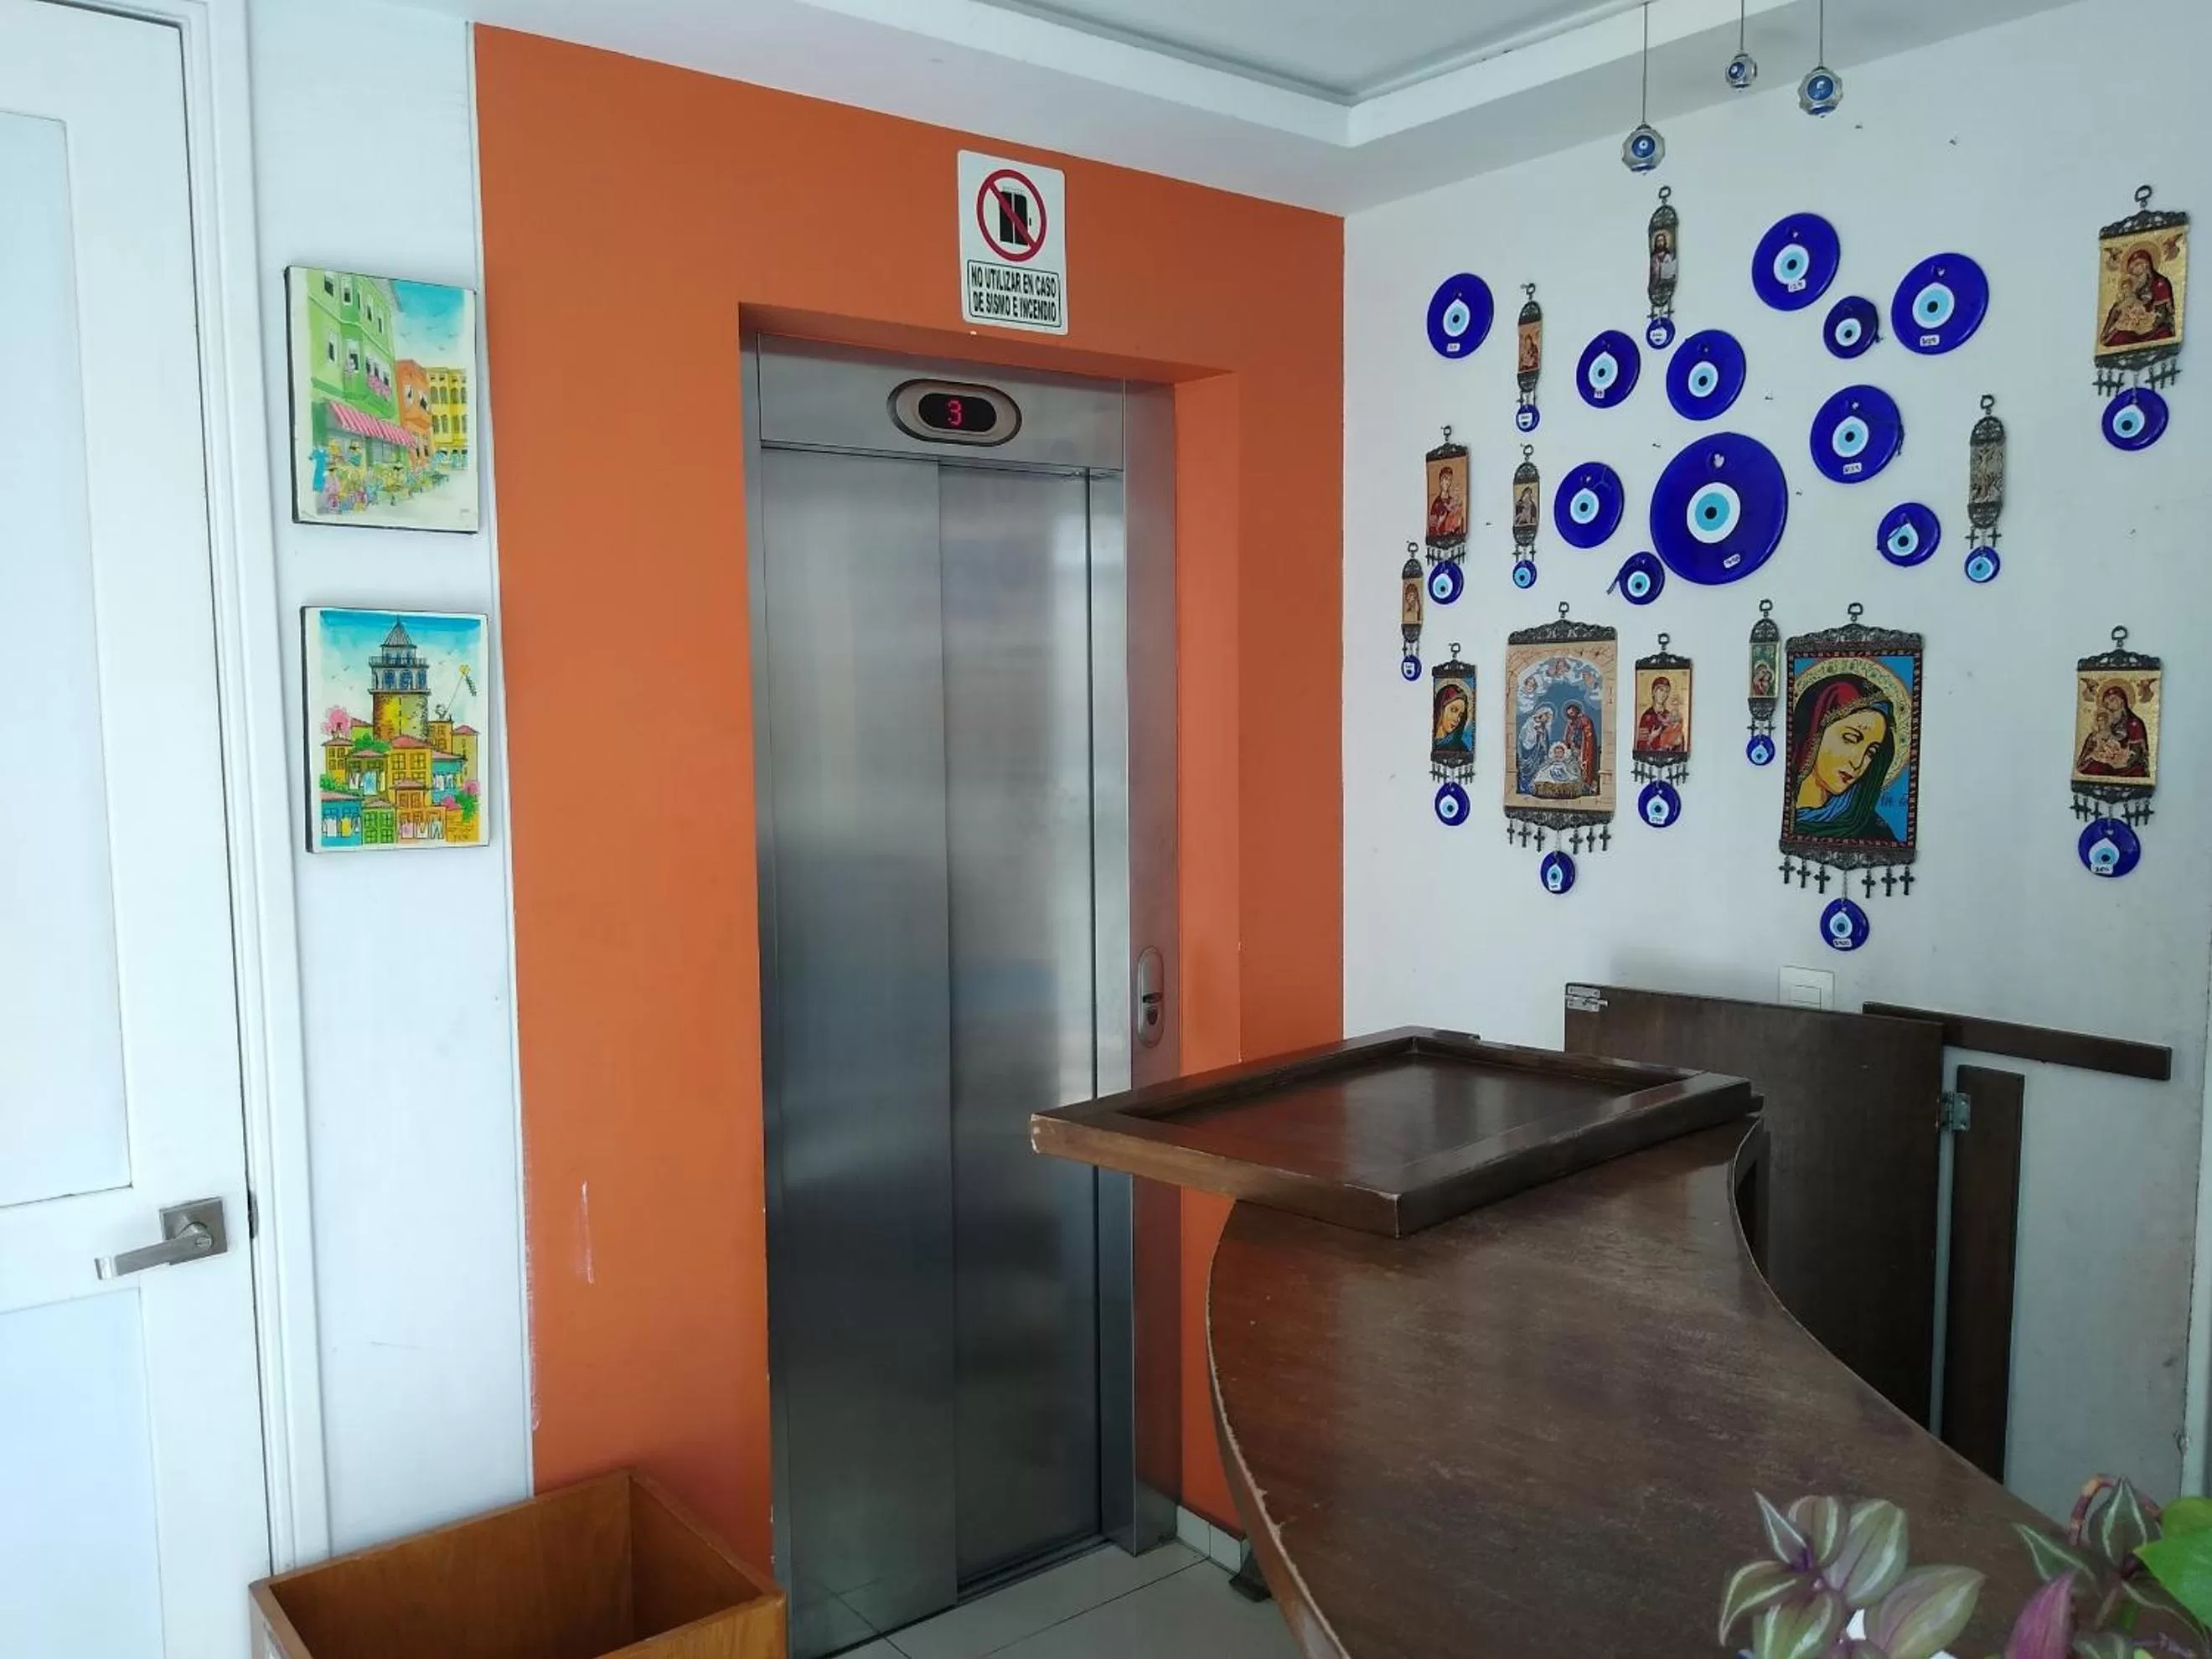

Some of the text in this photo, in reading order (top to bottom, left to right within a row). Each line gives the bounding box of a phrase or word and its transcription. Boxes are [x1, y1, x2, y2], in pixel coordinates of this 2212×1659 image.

[971, 265, 1057, 298] NO UTILIZAR EN CASO
[973, 291, 1057, 322] DE SISMO E INCENDIO
[947, 400, 963, 426] 3
